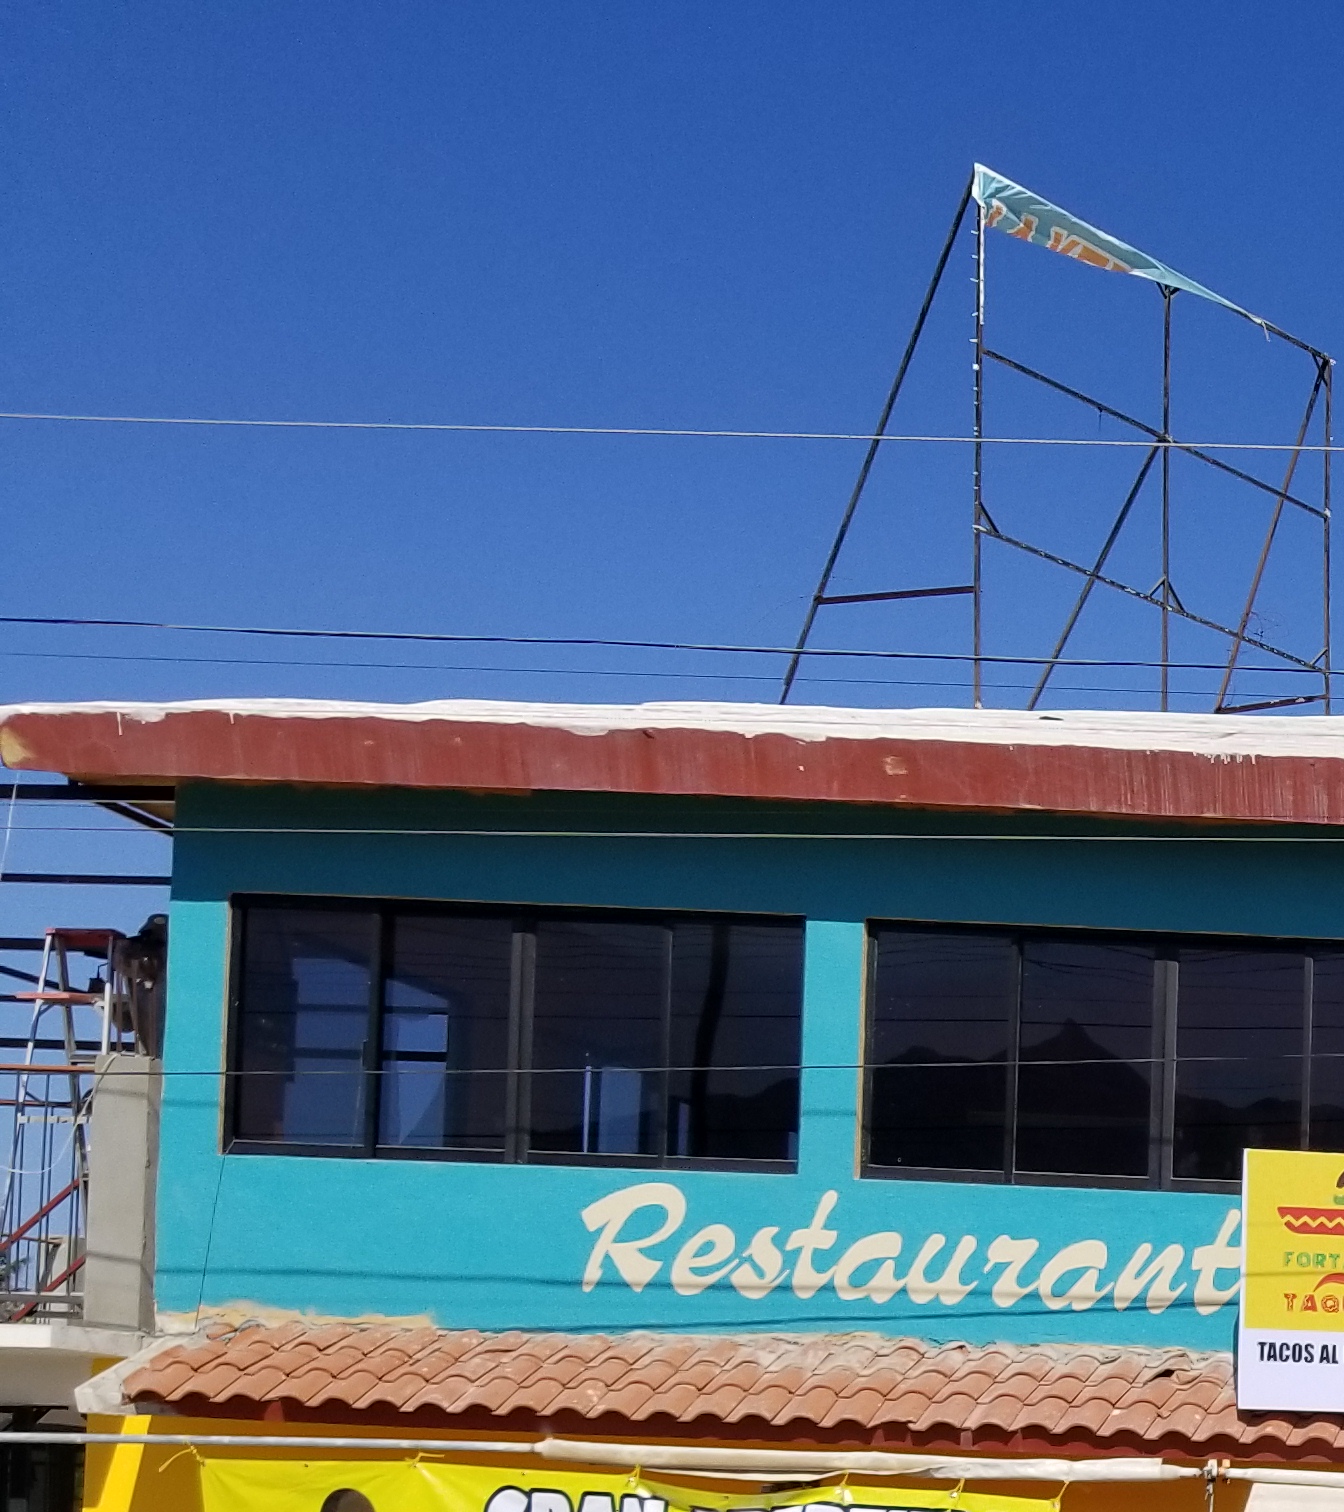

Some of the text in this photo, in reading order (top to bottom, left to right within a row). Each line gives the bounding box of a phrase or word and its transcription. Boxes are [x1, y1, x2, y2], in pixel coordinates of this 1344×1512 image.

[580, 1182, 1242, 1316] Restaurant
[1257, 1341, 1315, 1364] TACOS
[1319, 1344, 1338, 1364] AL
